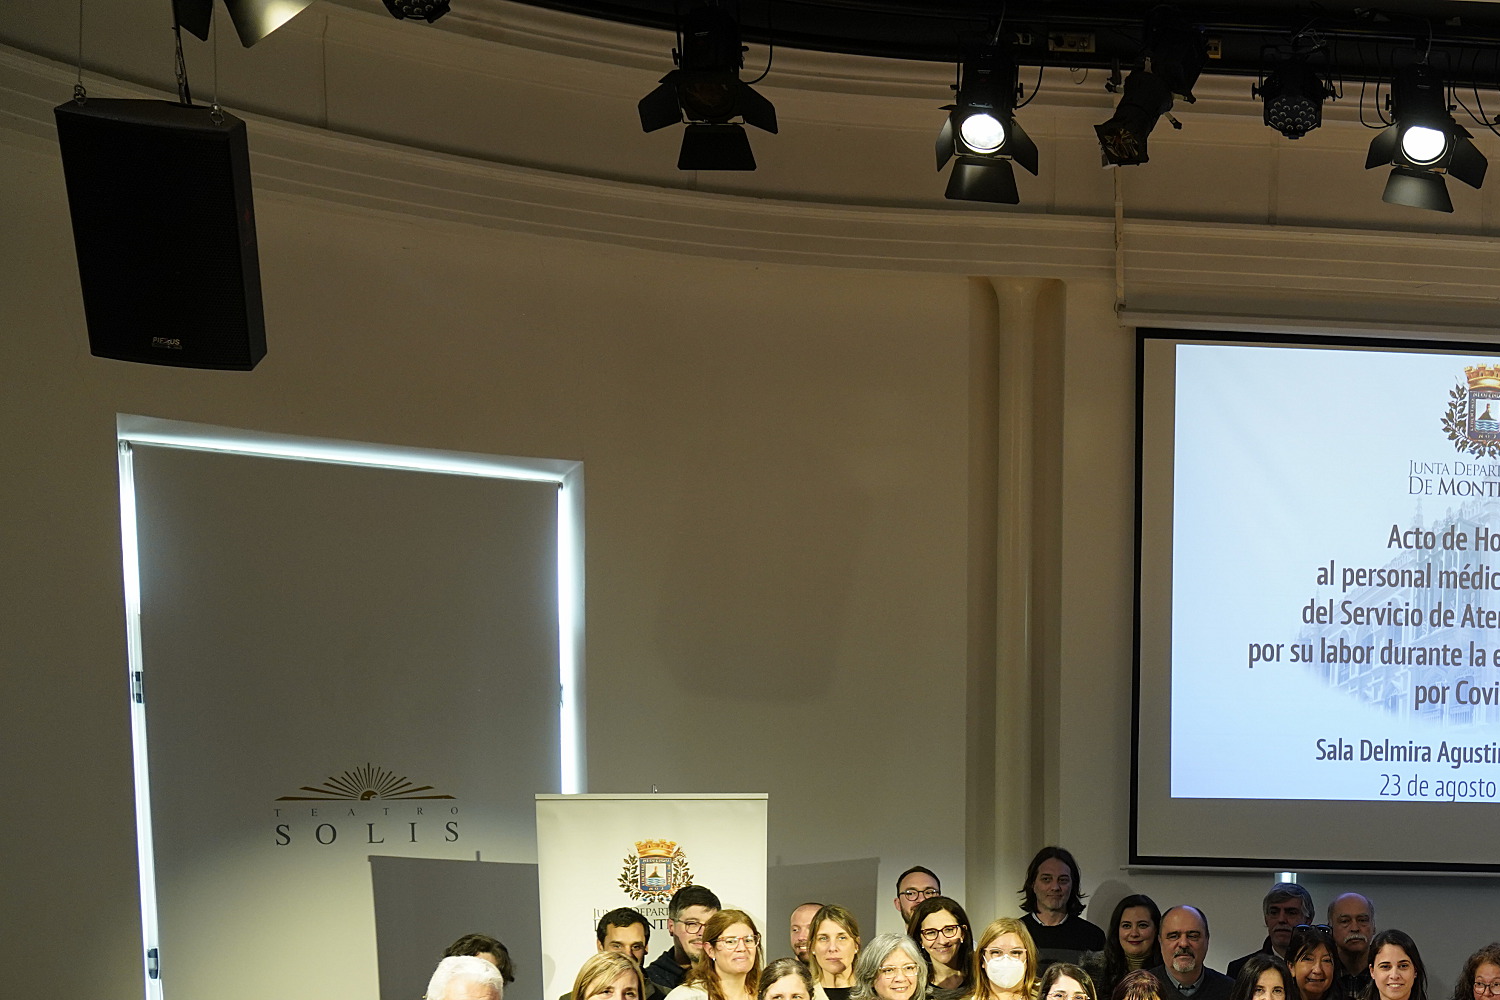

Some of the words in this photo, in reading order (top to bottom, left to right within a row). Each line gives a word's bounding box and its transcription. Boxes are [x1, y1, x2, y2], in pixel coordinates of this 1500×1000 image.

[1409, 460, 1450, 476] JUNTA
[1409, 476, 1432, 495] DE
[1387, 524, 1436, 550] Acto
[1442, 525, 1467, 551] de
[1316, 560, 1334, 585] al
[1342, 562, 1431, 593] personal
[1302, 598, 1333, 625] del
[1340, 600, 1423, 627] Servicio
[1429, 601, 1455, 628] de
[1248, 643, 1284, 668] por
[1289, 644, 1313, 663] su
[1320, 637, 1374, 665] labor
[1380, 638, 1463, 666] durante
[1469, 641, 1486, 666] la
[1414, 684, 1450, 710] por
[1315, 737, 1354, 761] Sala
[1360, 739, 1431, 762] Delmira
[1379, 773, 1401, 796] 23
[1407, 774, 1429, 797] de
[1435, 778, 1496, 802] agosto
[274, 806, 459, 818] TEATRO
[275, 821, 459, 846] SOLIS
